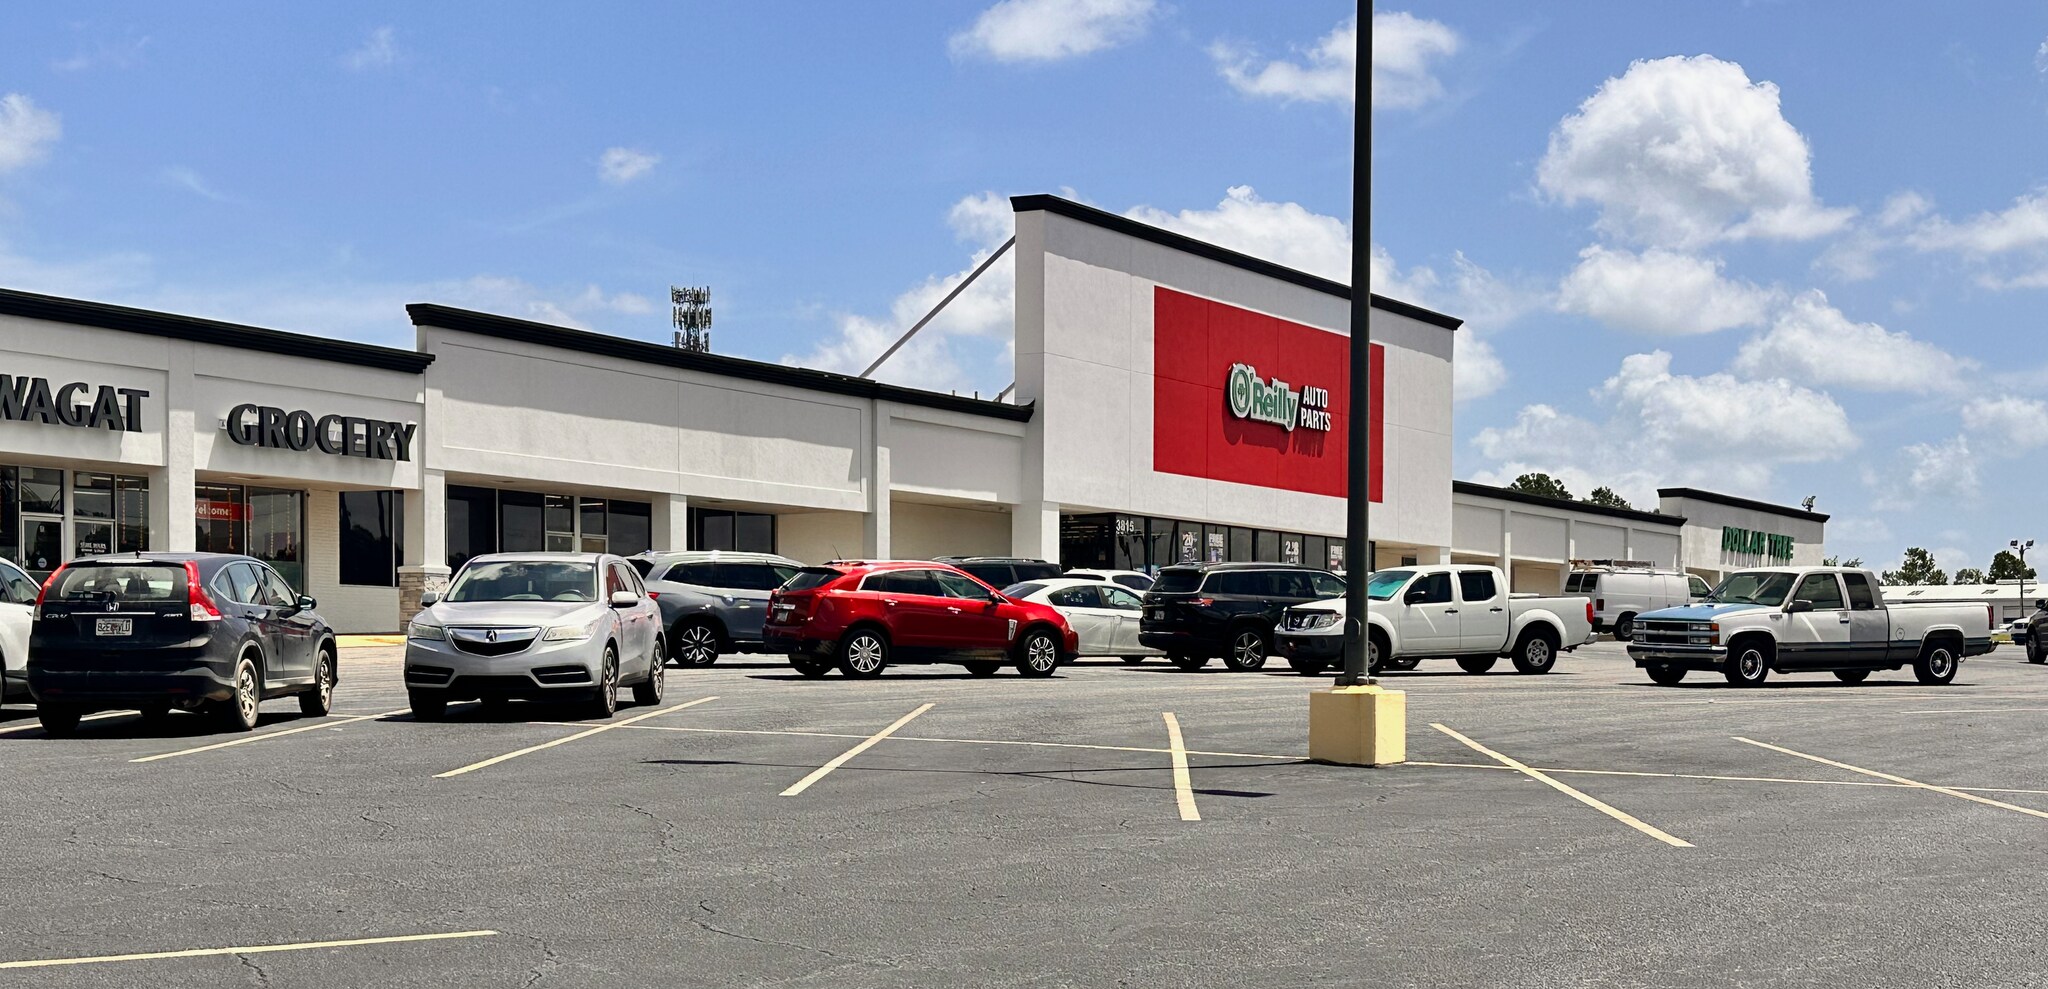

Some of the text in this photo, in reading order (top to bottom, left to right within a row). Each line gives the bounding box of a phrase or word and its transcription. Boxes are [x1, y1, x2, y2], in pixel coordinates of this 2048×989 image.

[1231, 368, 1298, 430] O'Reilly
[1302, 385, 1329, 408] AUTO
[227, 403, 417, 462] GROCERY
[1300, 407, 1331, 432] PARTS
[1721, 526, 1795, 560] DOLLAR TREE
